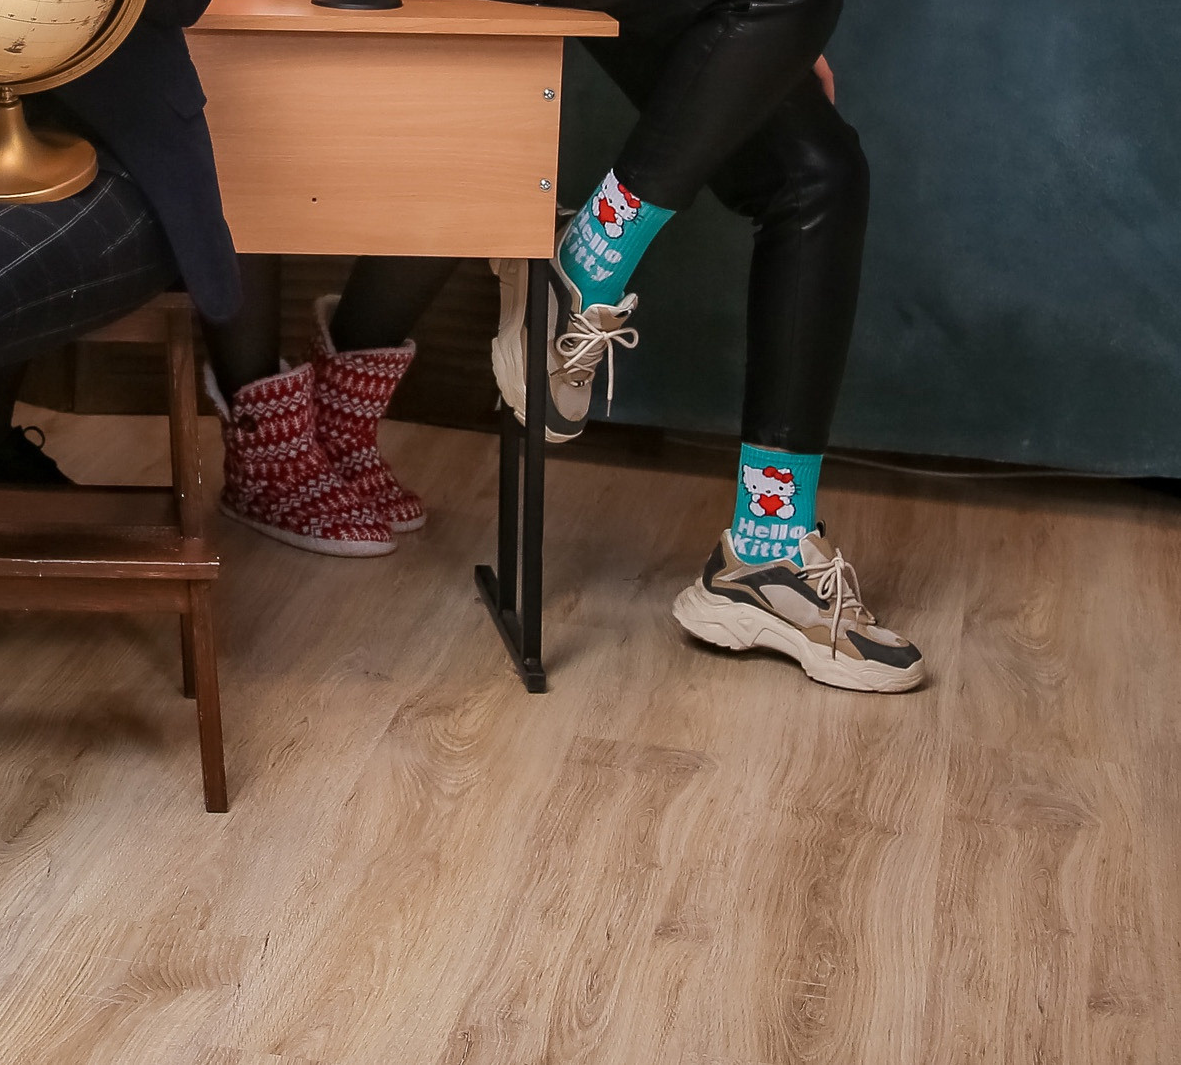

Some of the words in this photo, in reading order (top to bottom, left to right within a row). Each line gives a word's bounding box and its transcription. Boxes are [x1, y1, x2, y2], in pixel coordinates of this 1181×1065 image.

[565, 225, 615, 282] Kitty
[575, 208, 623, 264] Hello
[733, 533, 800, 560] Kitty
[739, 517, 807, 540] Hello
